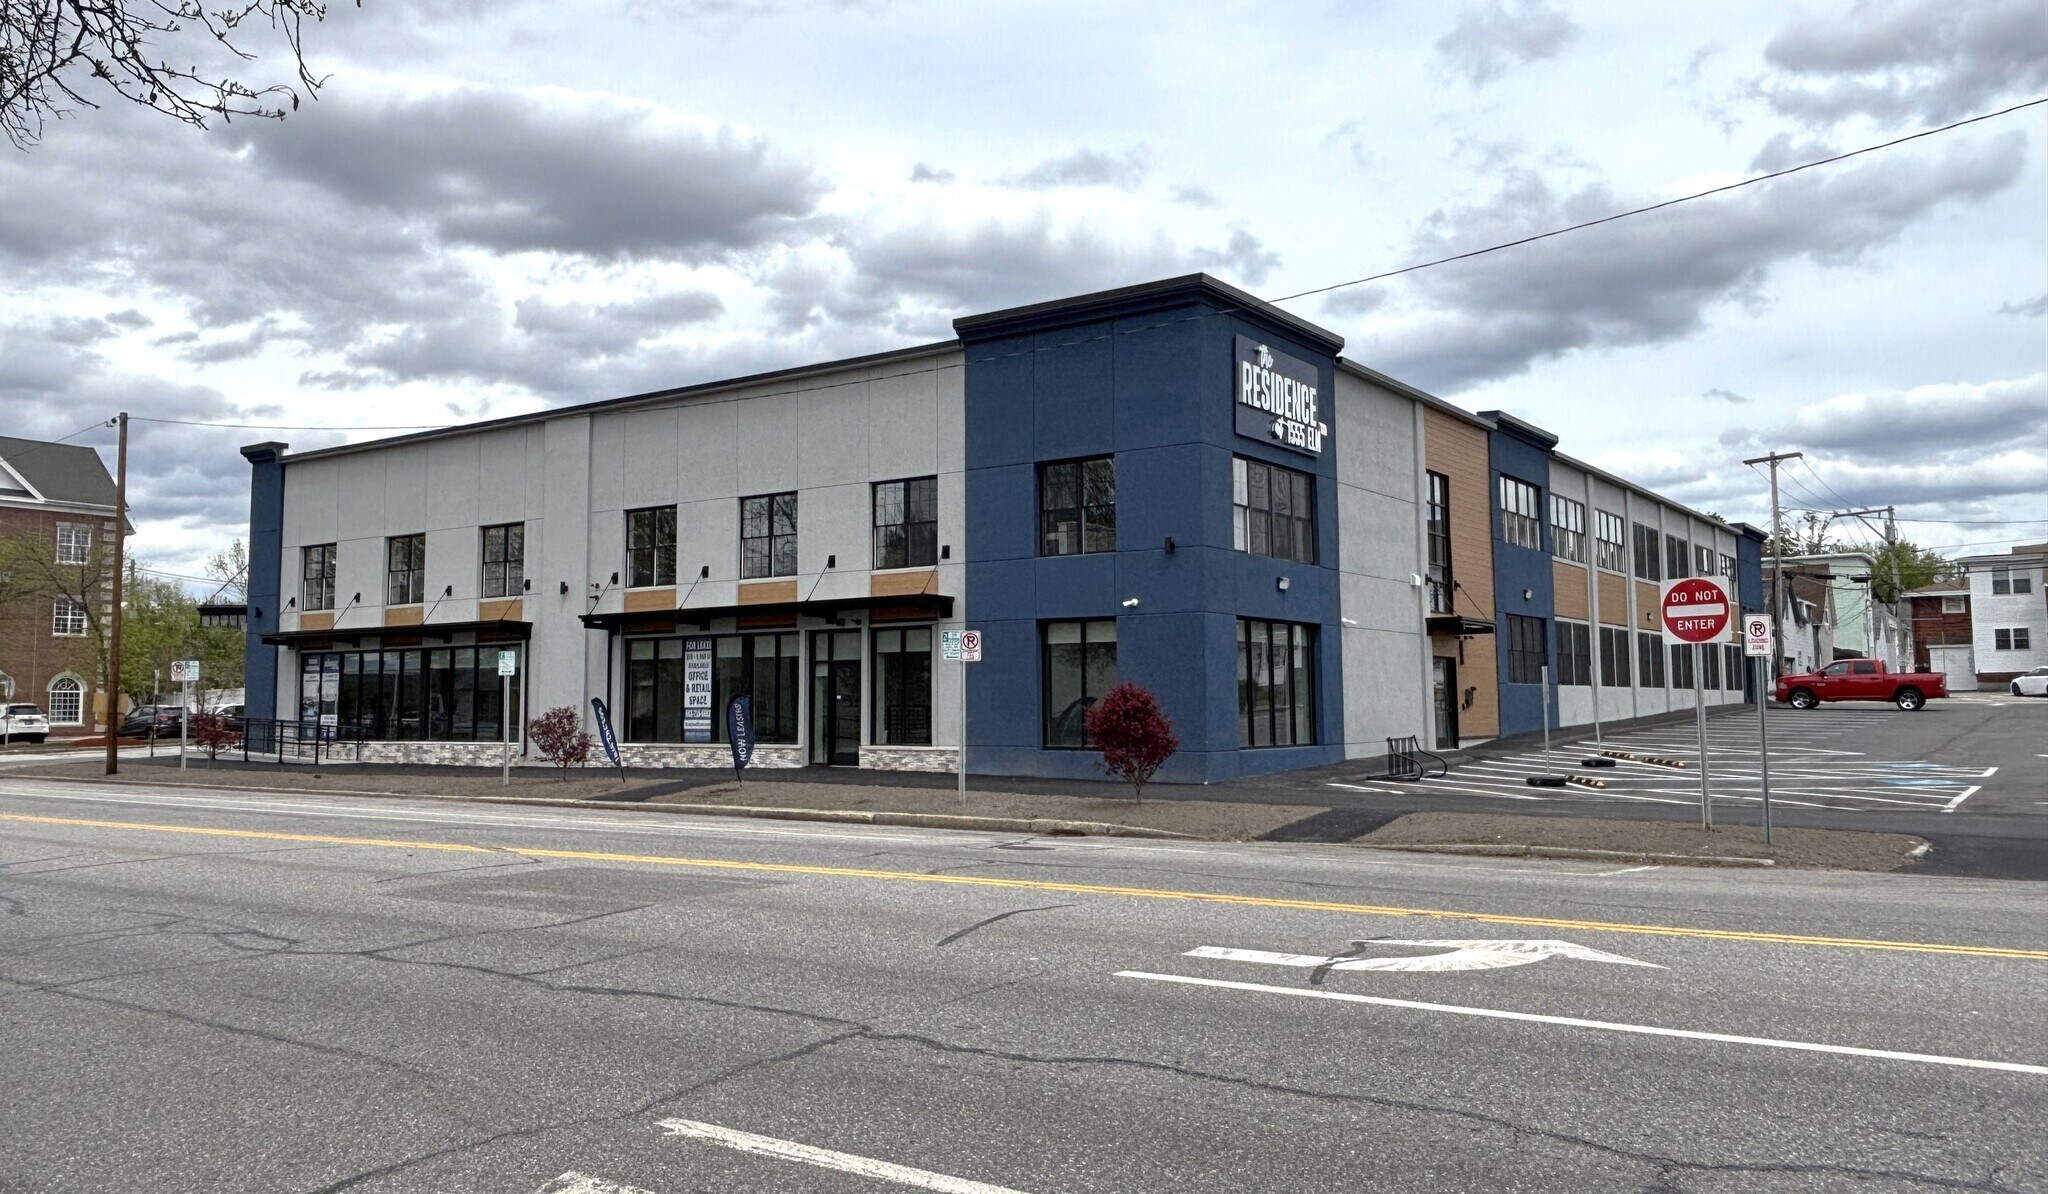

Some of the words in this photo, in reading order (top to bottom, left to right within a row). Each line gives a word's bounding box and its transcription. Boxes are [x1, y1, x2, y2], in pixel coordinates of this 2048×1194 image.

[1242, 360, 1317, 427] RESIDENCE
[1287, 419, 1306, 448] 1555
[1307, 426, 1322, 453] ELM
[1671, 592, 1688, 603] DO
[1695, 589, 1718, 602] NOT
[1677, 619, 1715, 631] ENTER
[686, 640, 696, 650] FOR
[688, 671, 709, 681] OFFICE
[691, 683, 711, 693] RETAIL
[688, 695, 708, 706] SPACE
[737, 738, 747, 762] NOW
